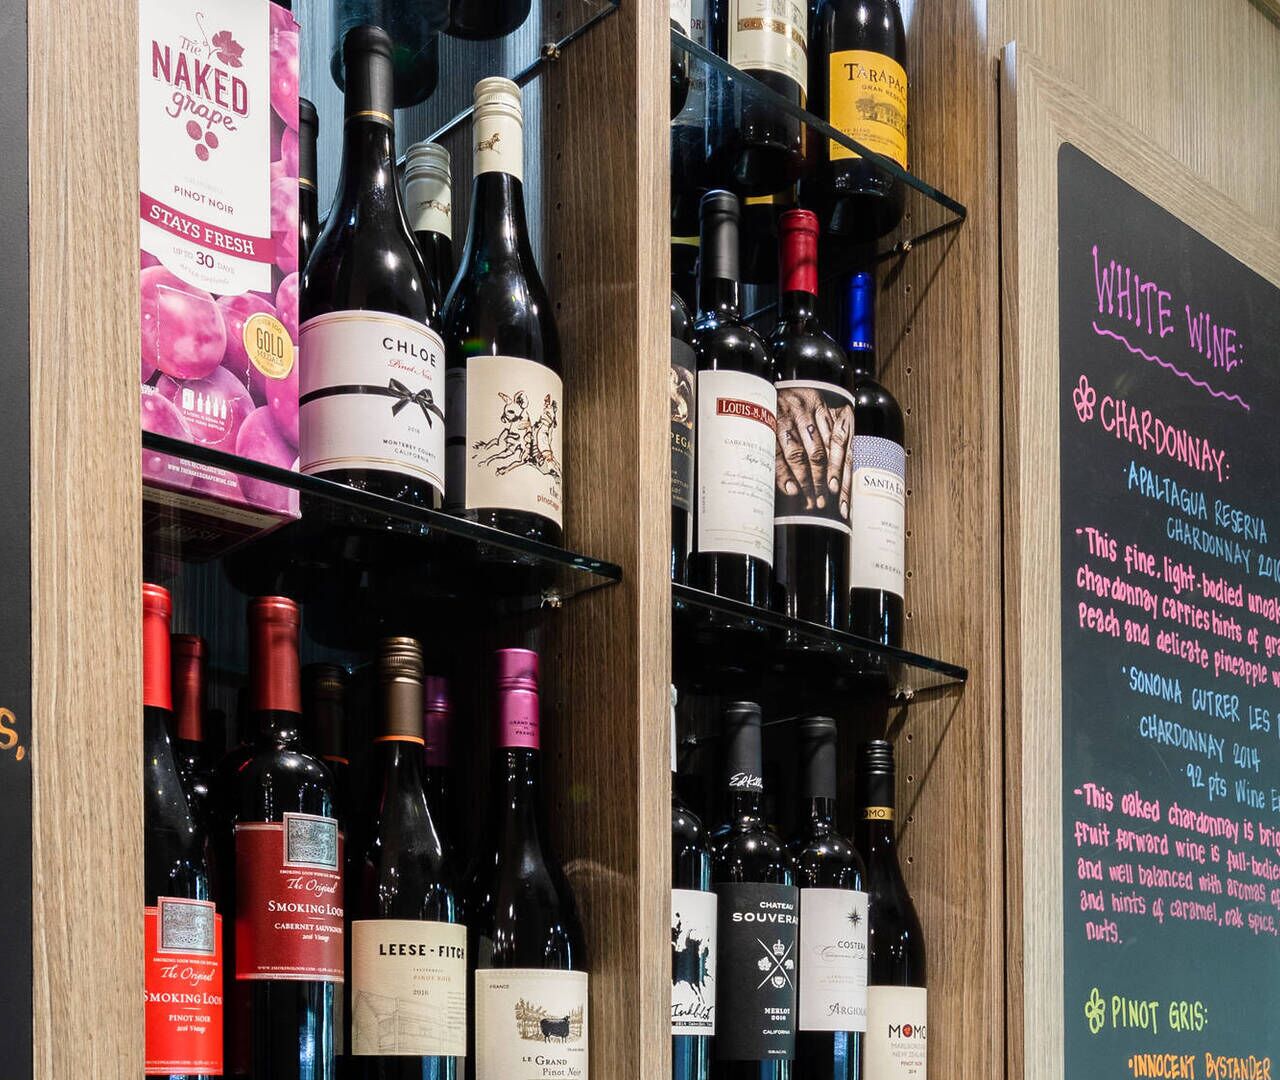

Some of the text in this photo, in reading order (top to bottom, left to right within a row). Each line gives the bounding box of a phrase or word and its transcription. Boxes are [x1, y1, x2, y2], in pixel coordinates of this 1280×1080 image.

[152, 40, 249, 118] NAKED
[166, 91, 237, 131] grape
[174, 186, 234, 215] PINOT NOIR
[150, 205, 255, 256] STAYS FRESH
[196, 252, 214, 268] 30
[1092, 245, 1244, 372] WHITE WINE:
[256, 328, 284, 358] GOLD
[383, 337, 436, 367] CHLOE
[722, 400, 750, 416] LOUIS
[1100, 396, 1231, 482] CHARDONNAY:
[864, 475, 895, 492] SANTA
[1215, 499, 1267, 544] RESERVA
[1167, 517, 1250, 571] CHARDONNAY
[1076, 567, 1158, 619] chardonnay
[1162, 601, 1210, 631] carries
[1212, 614, 1242, 642] hints
[1247, 628, 1258, 650] of
[1129, 666, 1183, 705] SONOMA
[1191, 688, 1240, 723] CUTRER
[1248, 705, 1270, 732] LES
[1139, 715, 1261, 773] CHARDONNAY 2014
[1208, 775, 1227, 801] pts
[1235, 779, 1265, 810] Wine
[305, 878, 337, 897] Original
[268, 900, 325, 915] SMOKING
[759, 901, 794, 910] CHATEAU
[379, 943, 426, 956] LEESE
[180, 966, 215, 986] Original
[1111, 995, 1209, 1035] PINOT GRIS:
[542, 1067, 566, 1077] Pinot
